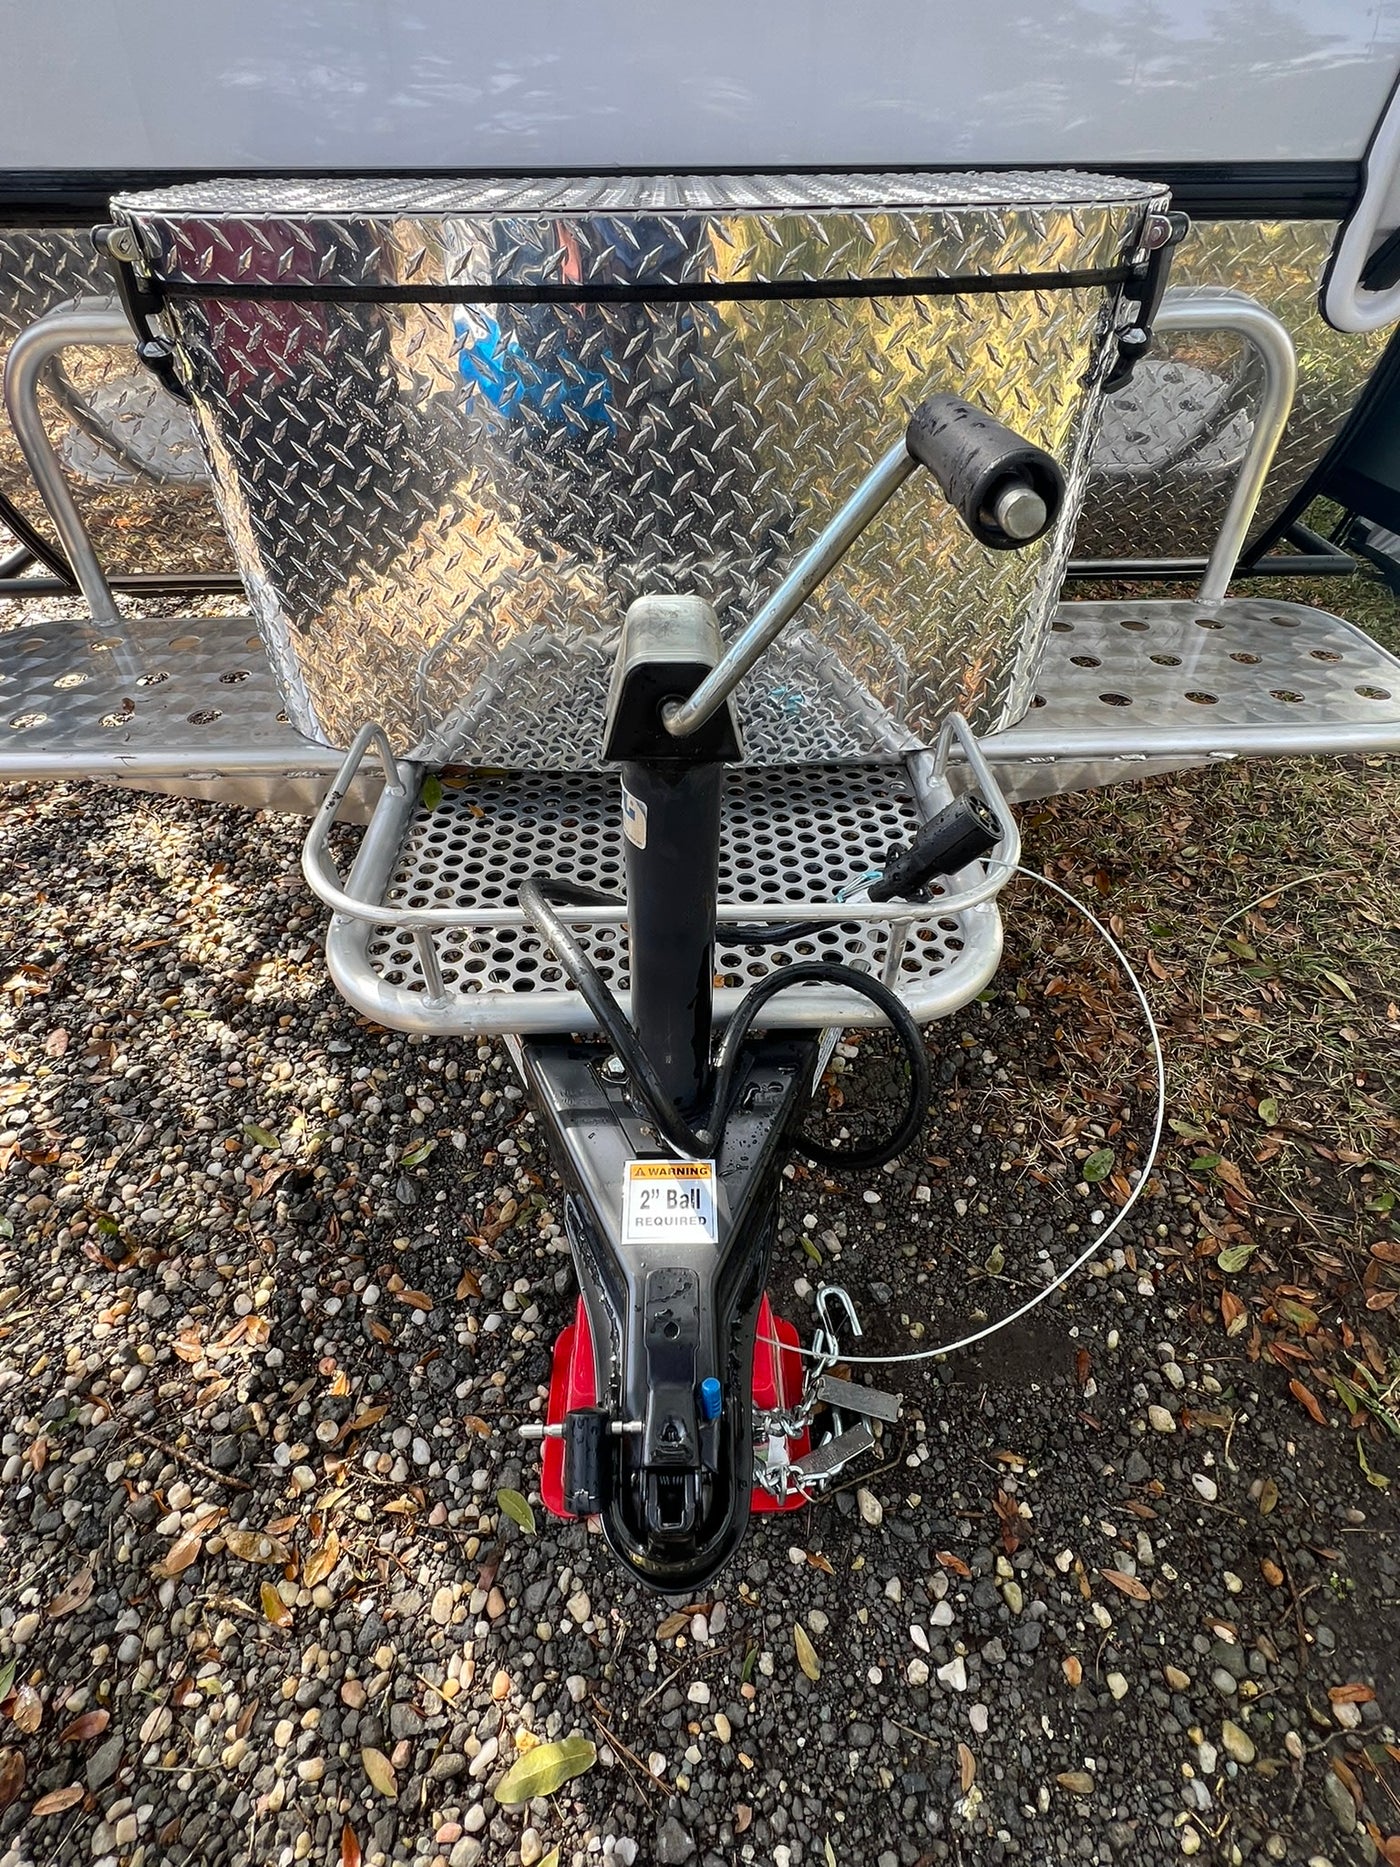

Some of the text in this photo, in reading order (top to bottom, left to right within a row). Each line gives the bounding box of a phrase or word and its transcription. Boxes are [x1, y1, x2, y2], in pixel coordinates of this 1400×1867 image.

[648, 1167, 708, 1176] WARNING
[666, 1189, 701, 1210] Ball
[635, 1216, 707, 1227] REQUIRED
